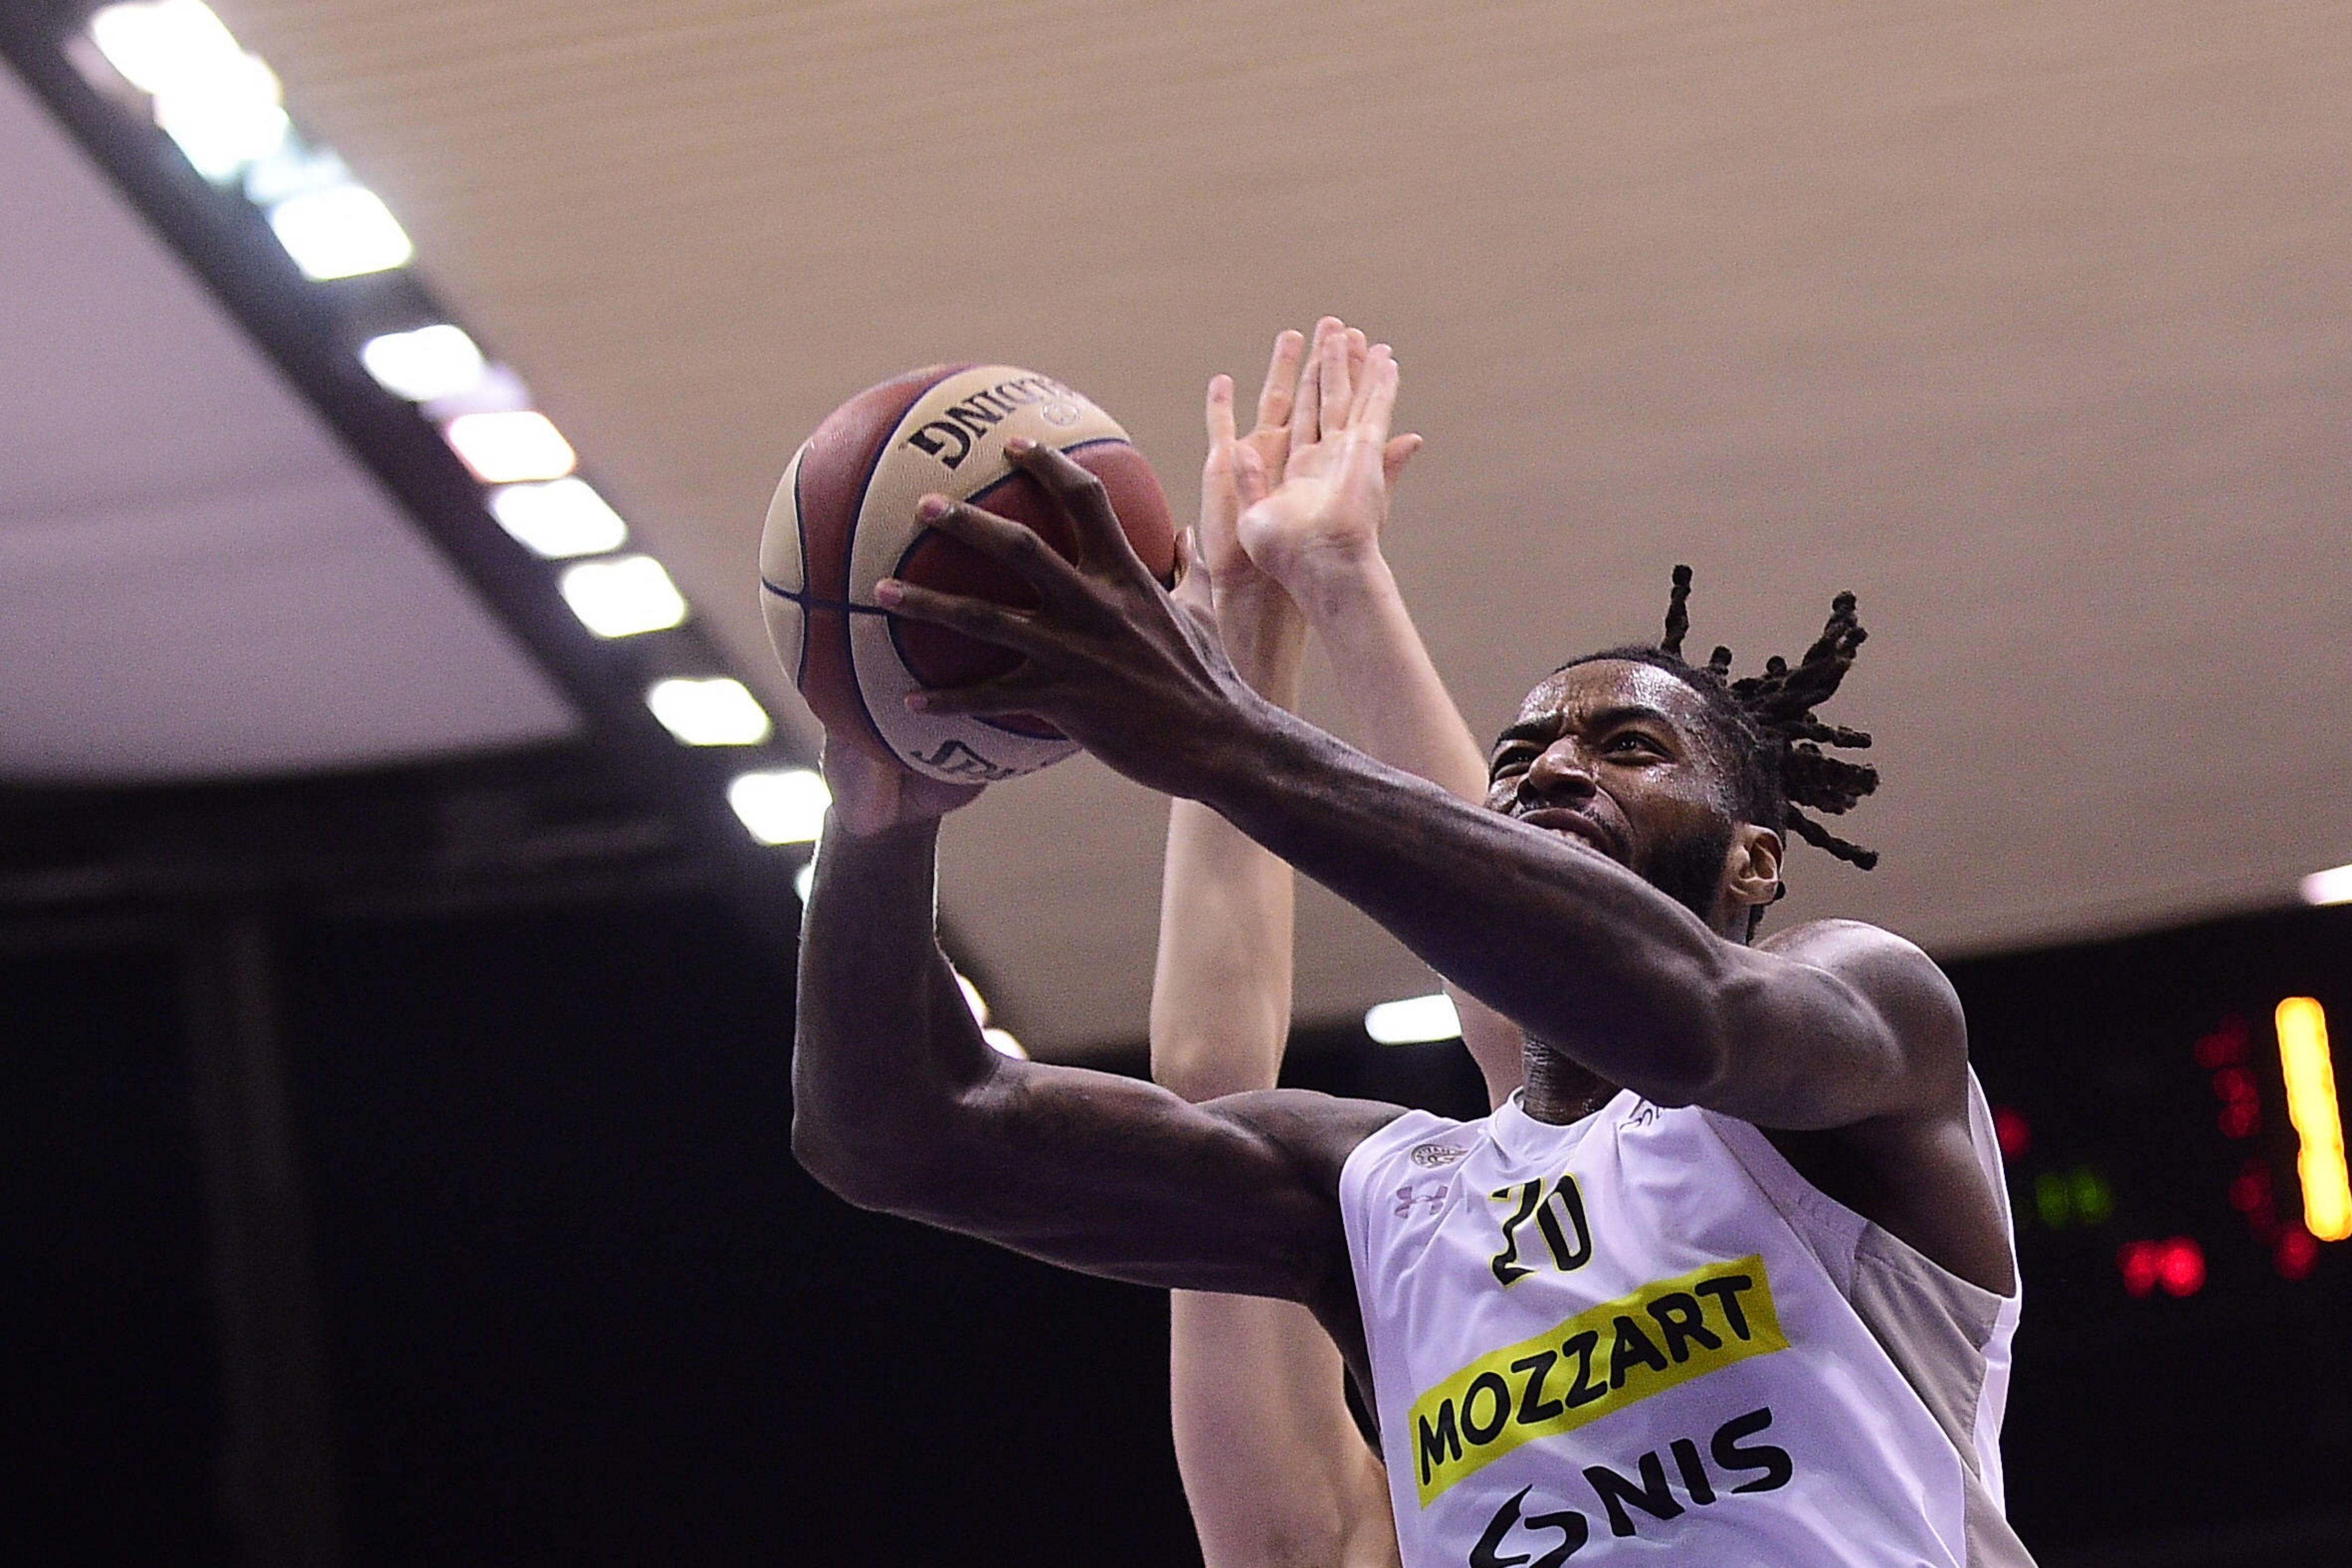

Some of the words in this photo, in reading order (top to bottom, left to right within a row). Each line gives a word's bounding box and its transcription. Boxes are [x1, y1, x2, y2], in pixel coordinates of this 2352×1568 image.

[1489, 1173, 1593, 1288] 20
[1418, 1274, 1753, 1486] MOZZART
[1582, 1406, 1793, 1537] NIS
